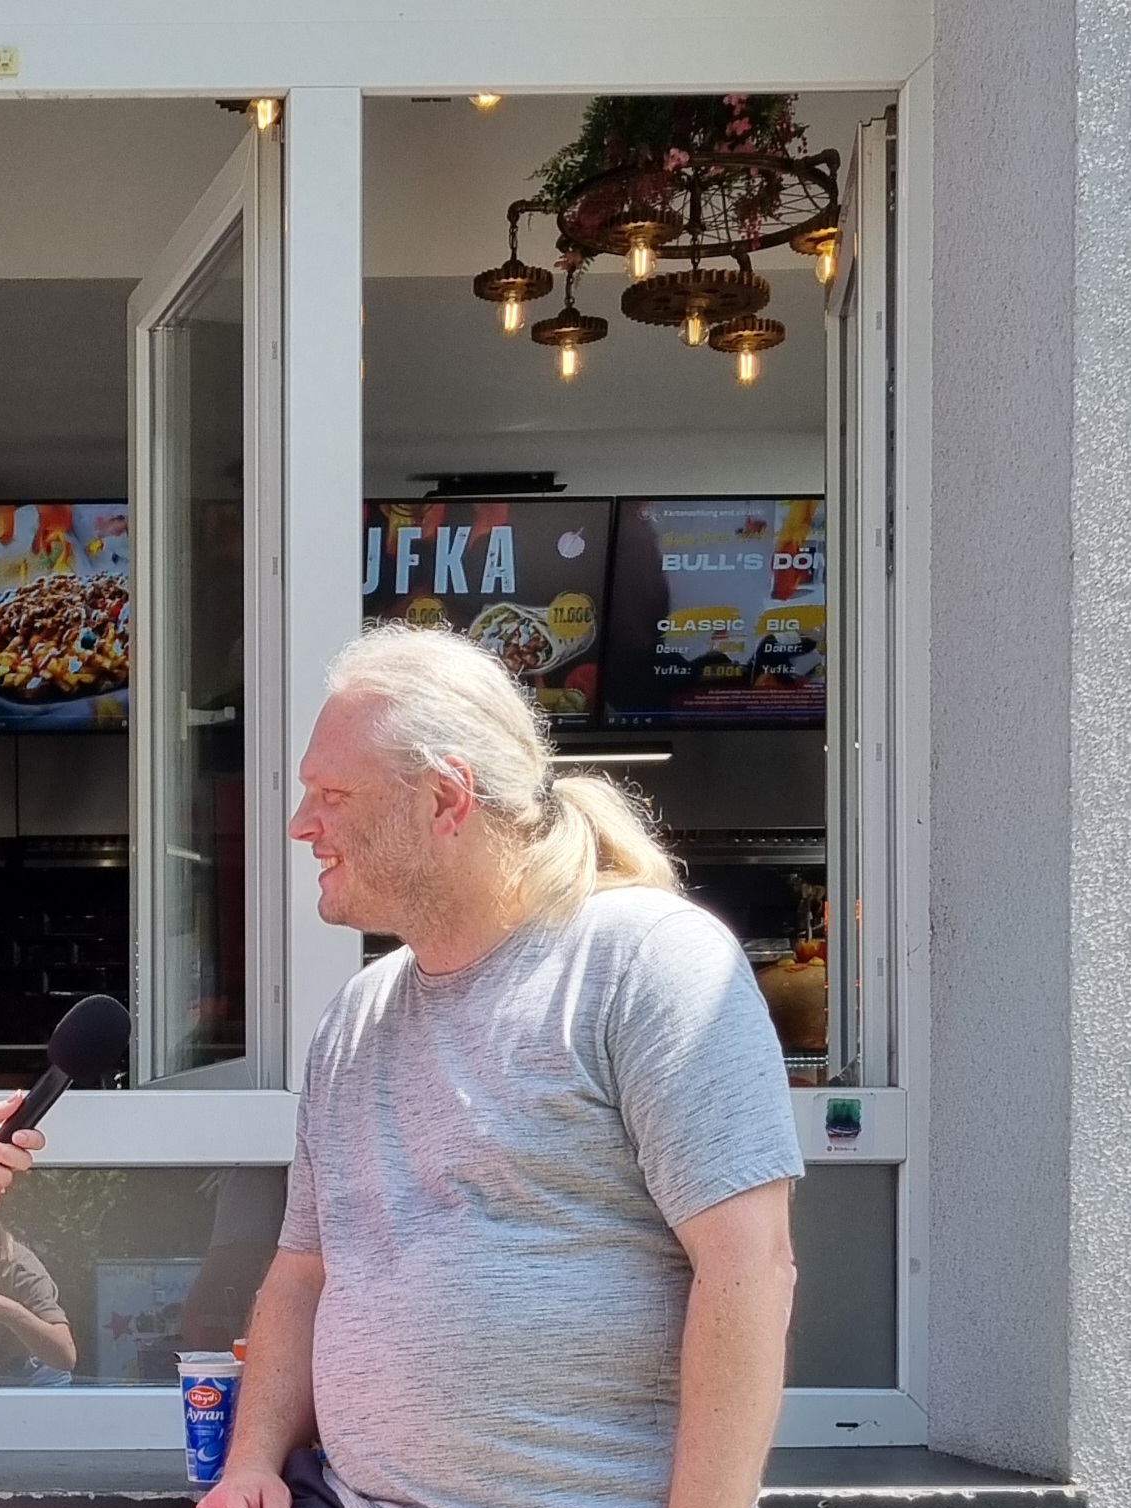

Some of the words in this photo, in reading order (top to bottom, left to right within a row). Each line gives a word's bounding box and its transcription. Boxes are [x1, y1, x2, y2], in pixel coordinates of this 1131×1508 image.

[661, 552, 764, 571] BULL'S
[553, 606, 592, 624] 11.00€
[656, 619, 746, 632] CLASSIC
[766, 619, 800, 631] BIG
[186, 1407, 225, 1424] Ayran
